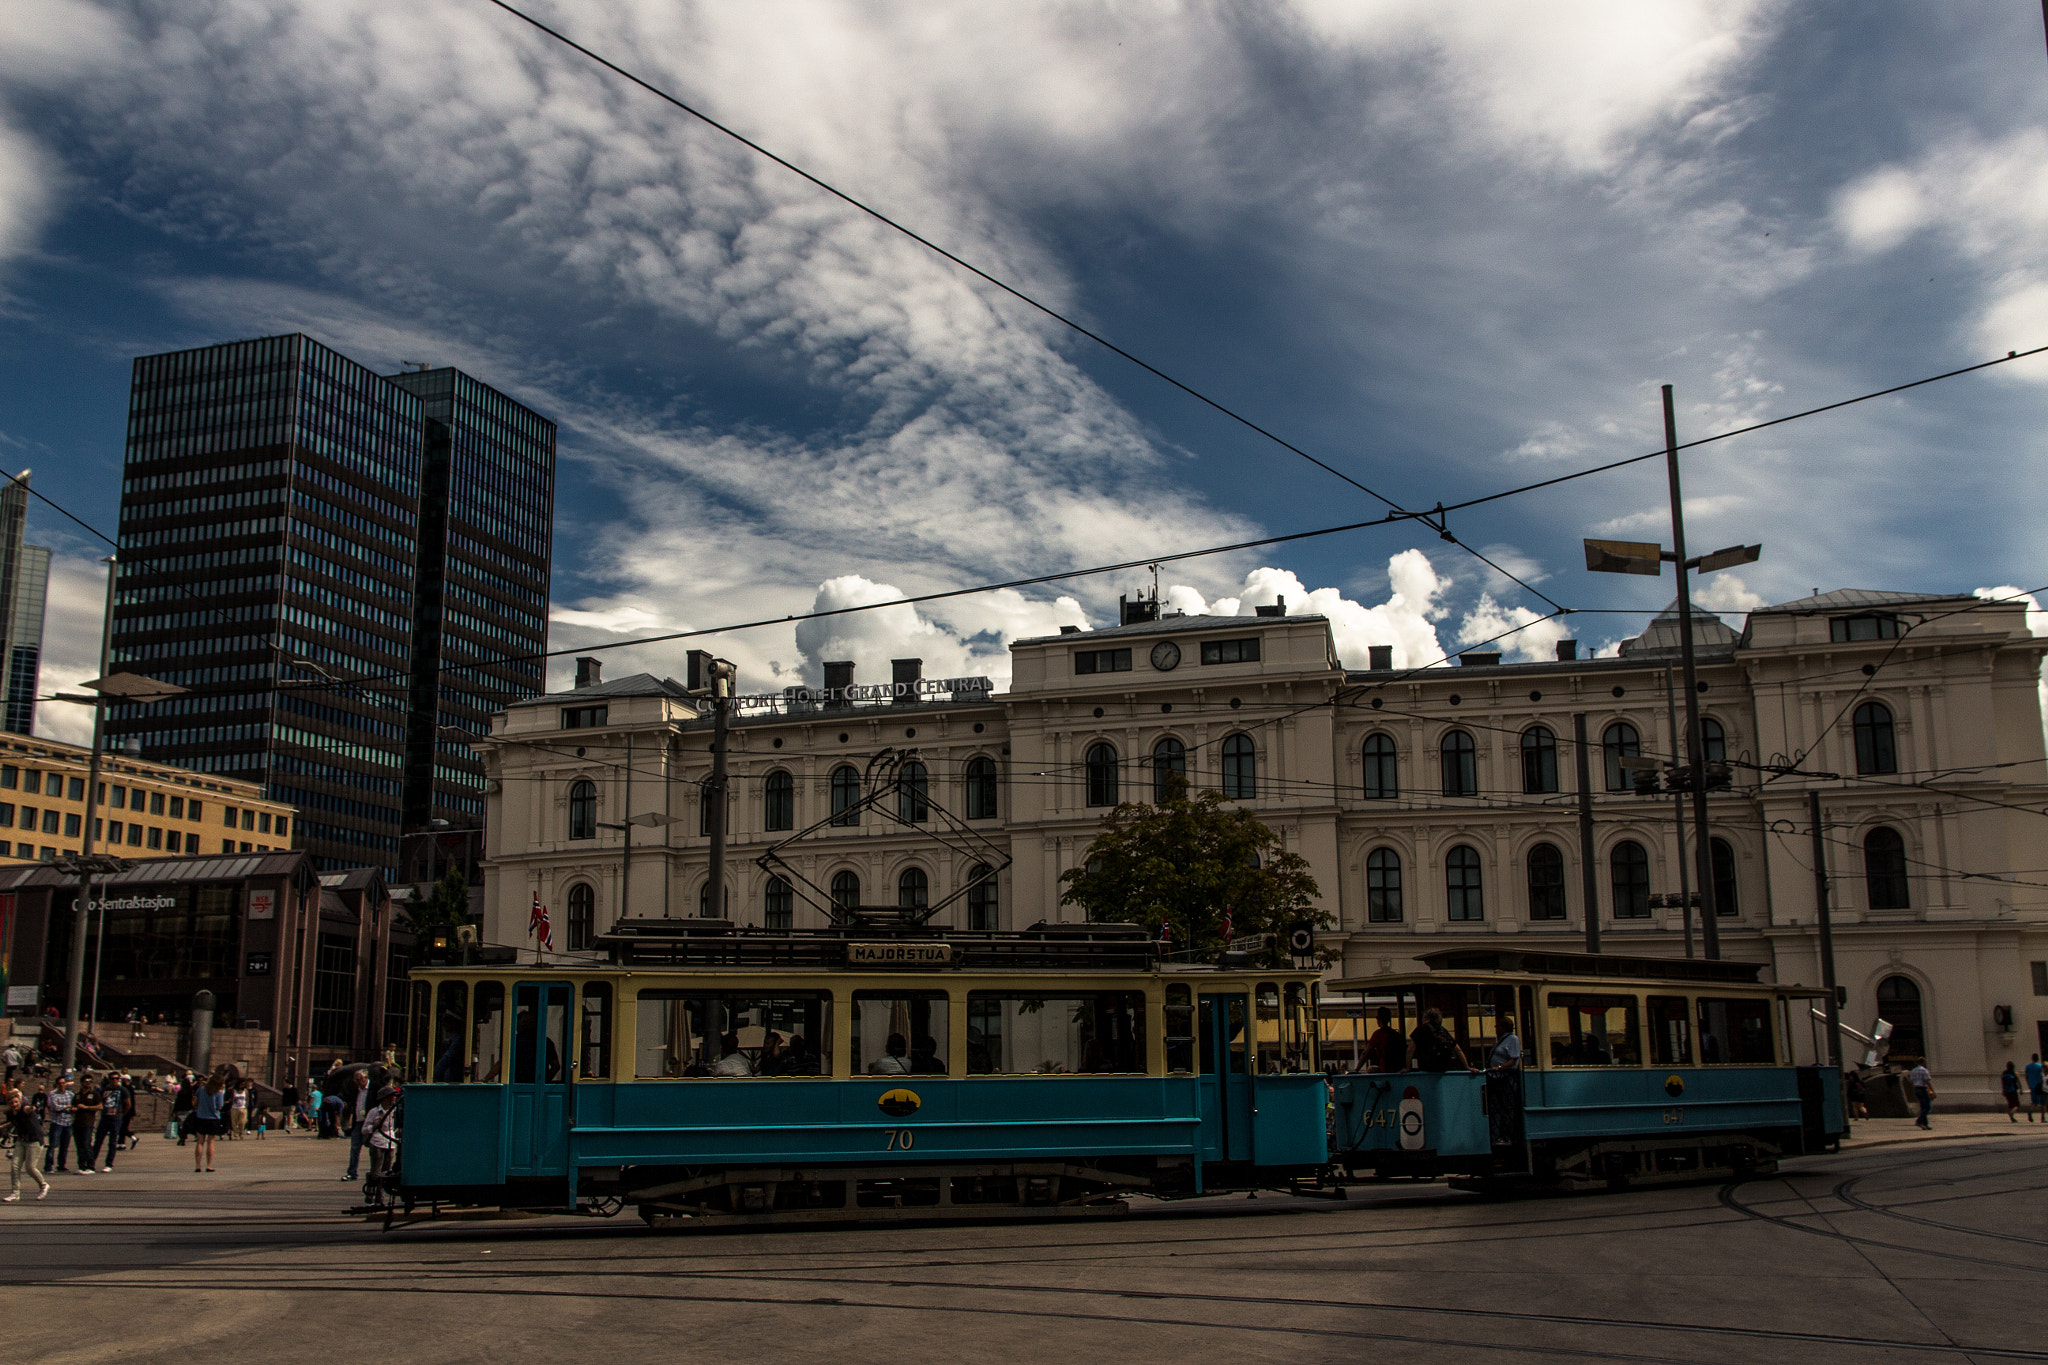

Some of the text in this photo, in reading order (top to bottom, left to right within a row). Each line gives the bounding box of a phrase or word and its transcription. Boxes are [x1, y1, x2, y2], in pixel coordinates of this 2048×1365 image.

[783, 687, 839, 706] HOTEL
[844, 683, 908, 701] GRAND
[912, 676, 993, 696] CENTRAL
[71, 895, 176, 912] Oo Sentralstasjon
[855, 948, 945, 960] MAJORSTUA
[1363, 1108, 1397, 1129] 647
[1664, 1106, 1685, 1125] 647
[884, 1129, 914, 1151] 70
